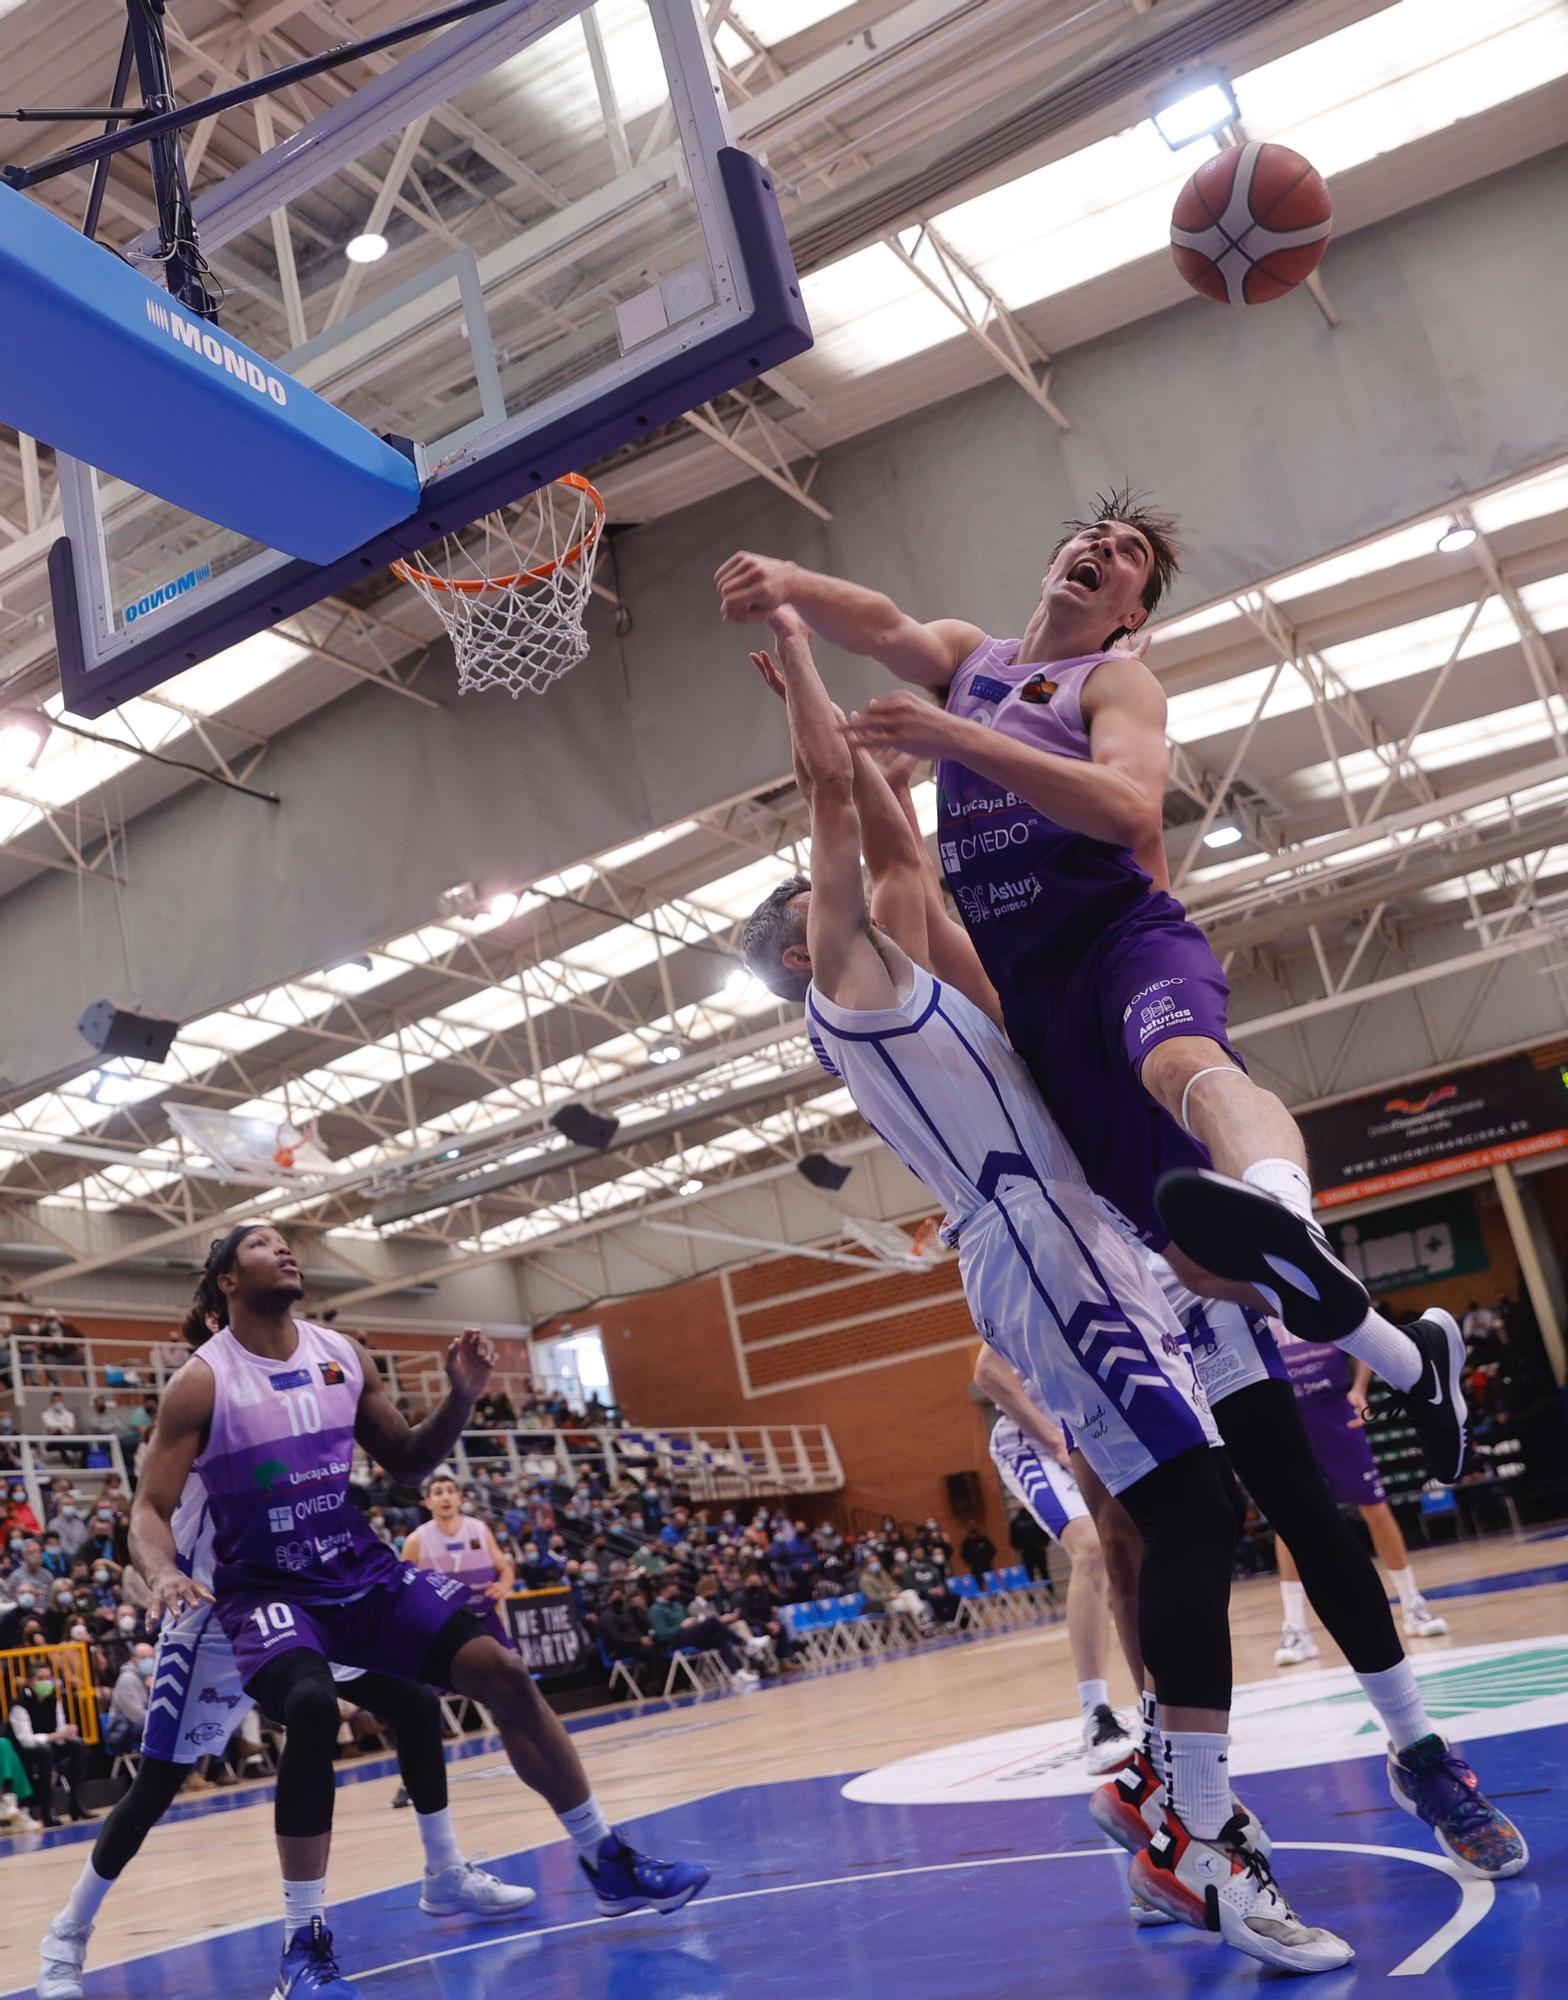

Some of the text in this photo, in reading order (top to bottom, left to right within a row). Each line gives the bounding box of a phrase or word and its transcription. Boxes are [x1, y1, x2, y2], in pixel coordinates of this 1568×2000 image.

[171, 312, 287, 406] MONDO
[1140, 1008, 1192, 1038] Asturias
[1166, 1016, 1194, 1027] natural
[280, 1391, 322, 1437] 10
[451, 1553, 462, 1573] 7
[250, 1602, 295, 1637] 10
[514, 1604, 572, 1636] WE THE
